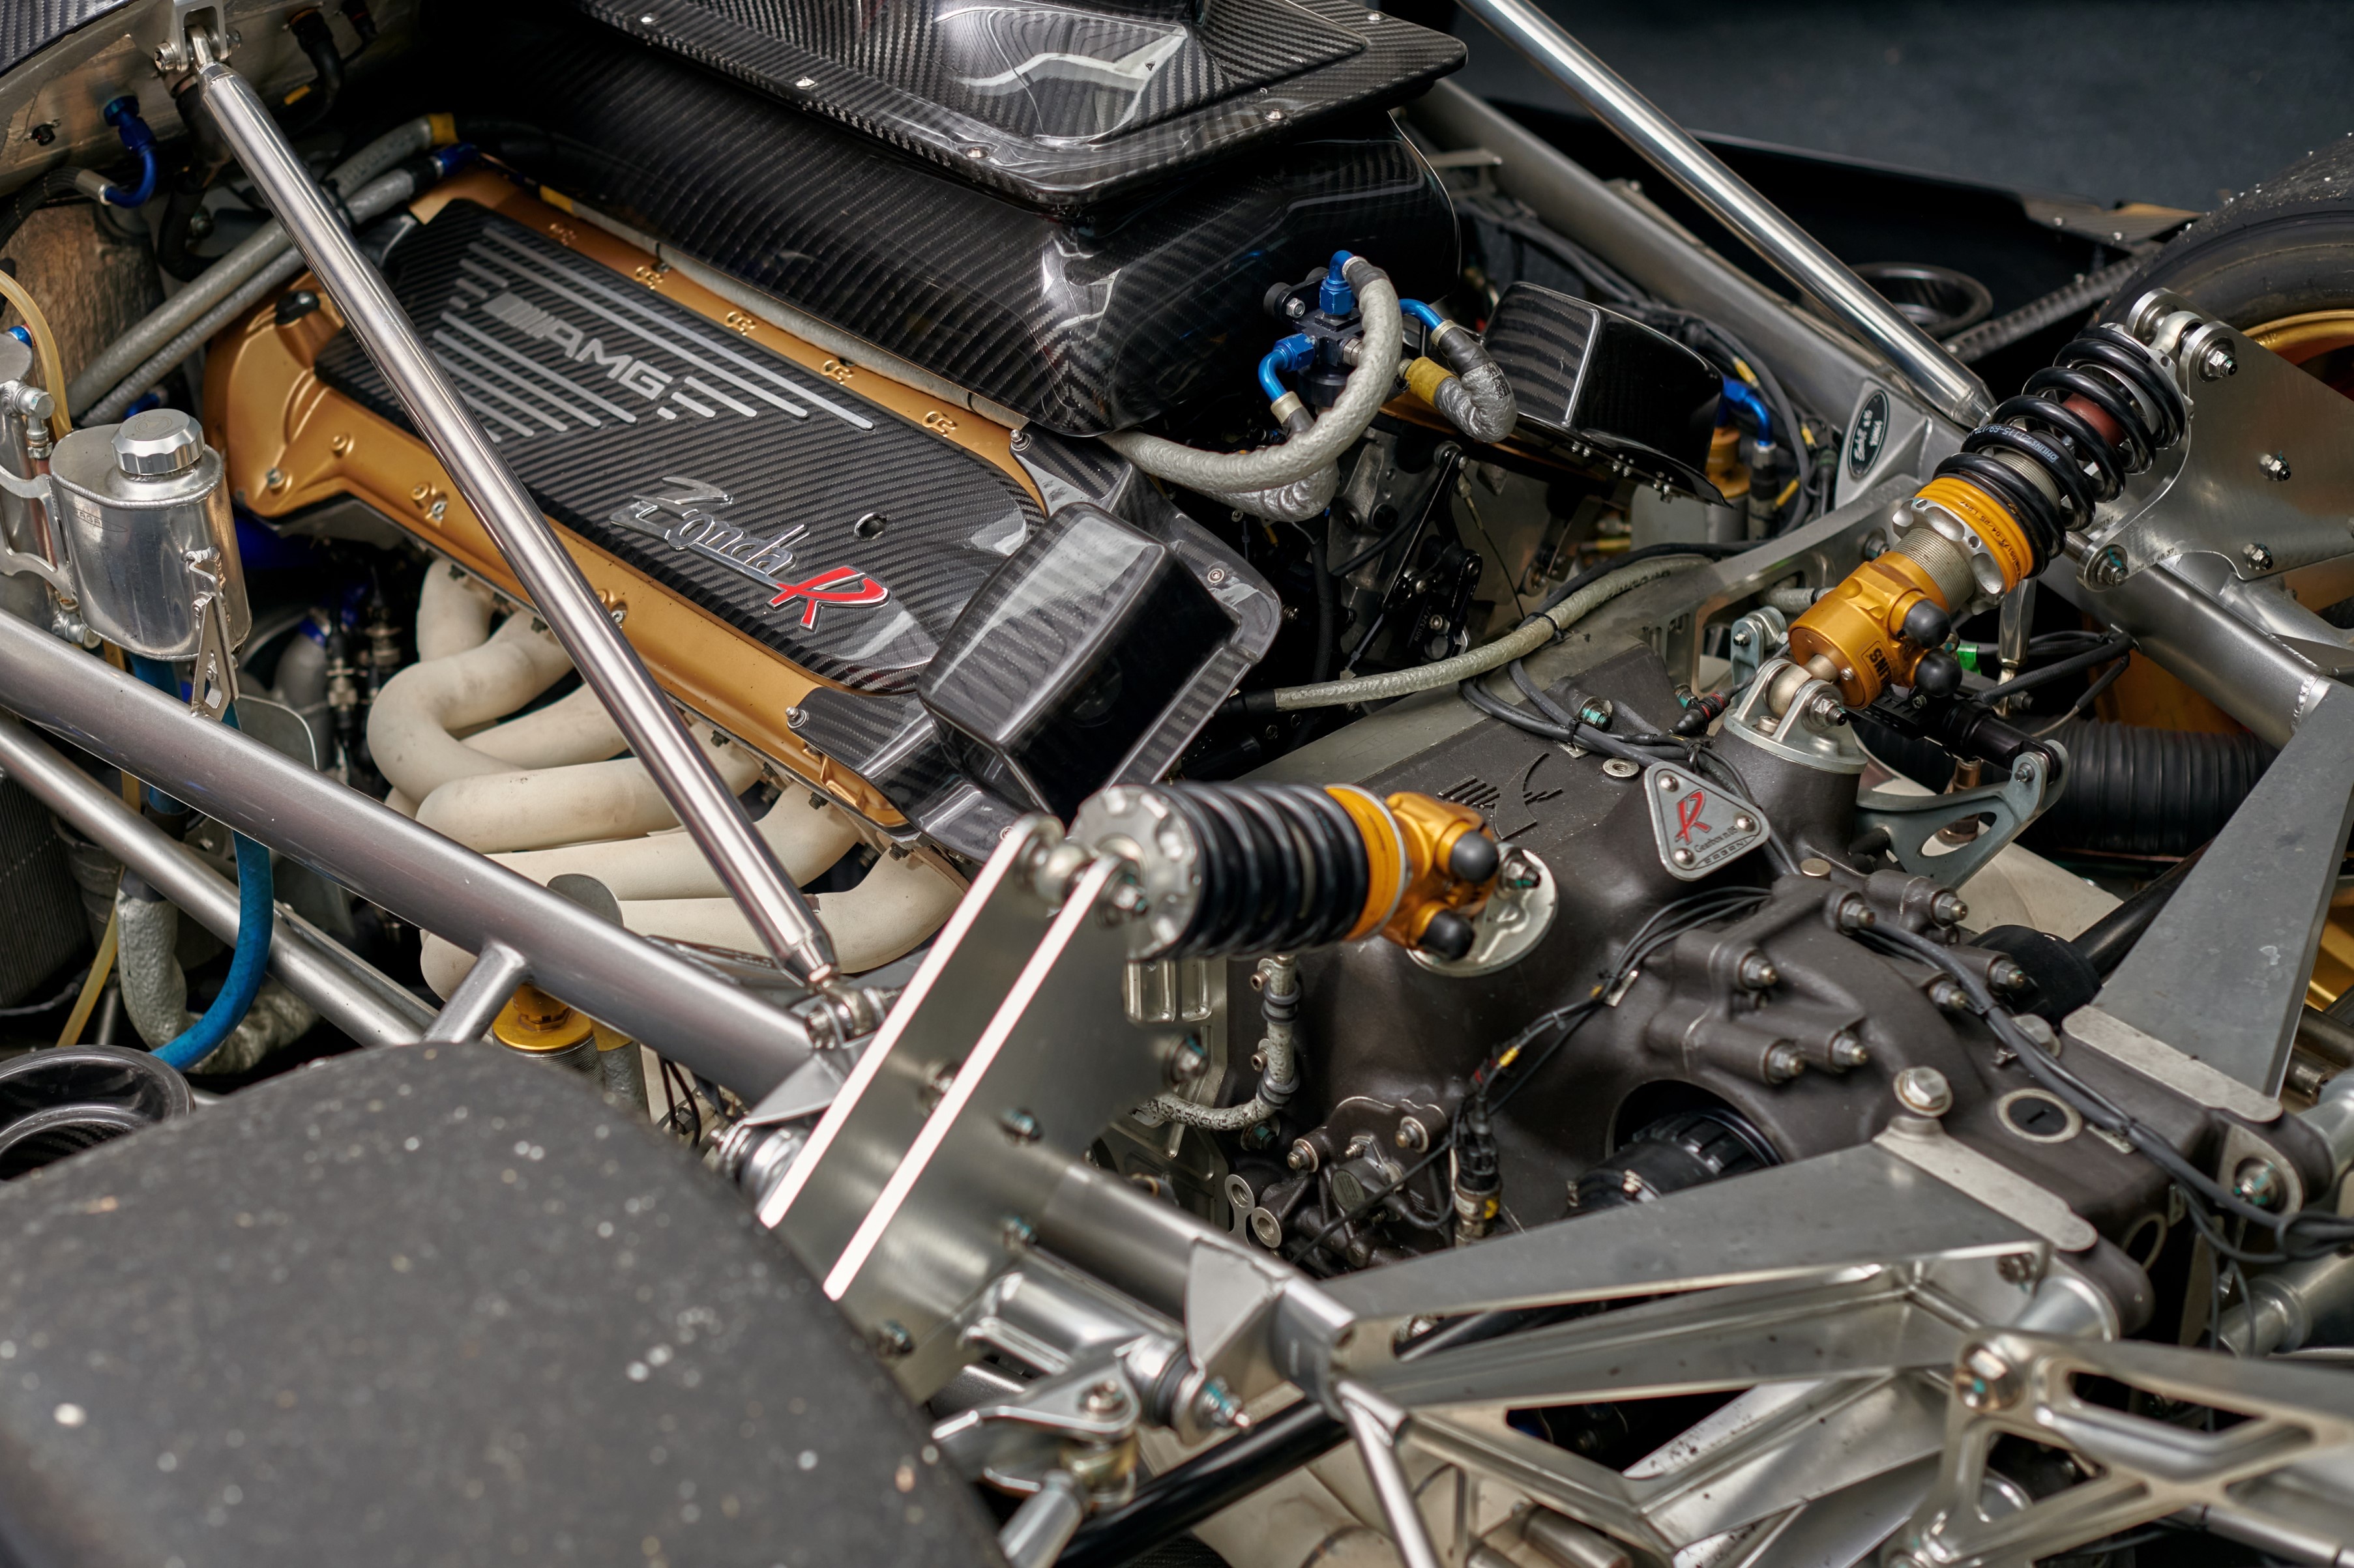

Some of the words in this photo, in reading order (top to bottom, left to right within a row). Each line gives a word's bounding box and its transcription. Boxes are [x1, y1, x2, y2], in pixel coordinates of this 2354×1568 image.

[544, 319, 673, 399] AMG
[609, 476, 808, 580] Zonda
[767, 566, 890, 632] R
[1868, 648, 1892, 686] LINS
[1675, 789, 1711, 845] R
[1703, 839, 1748, 864] PAGANI
